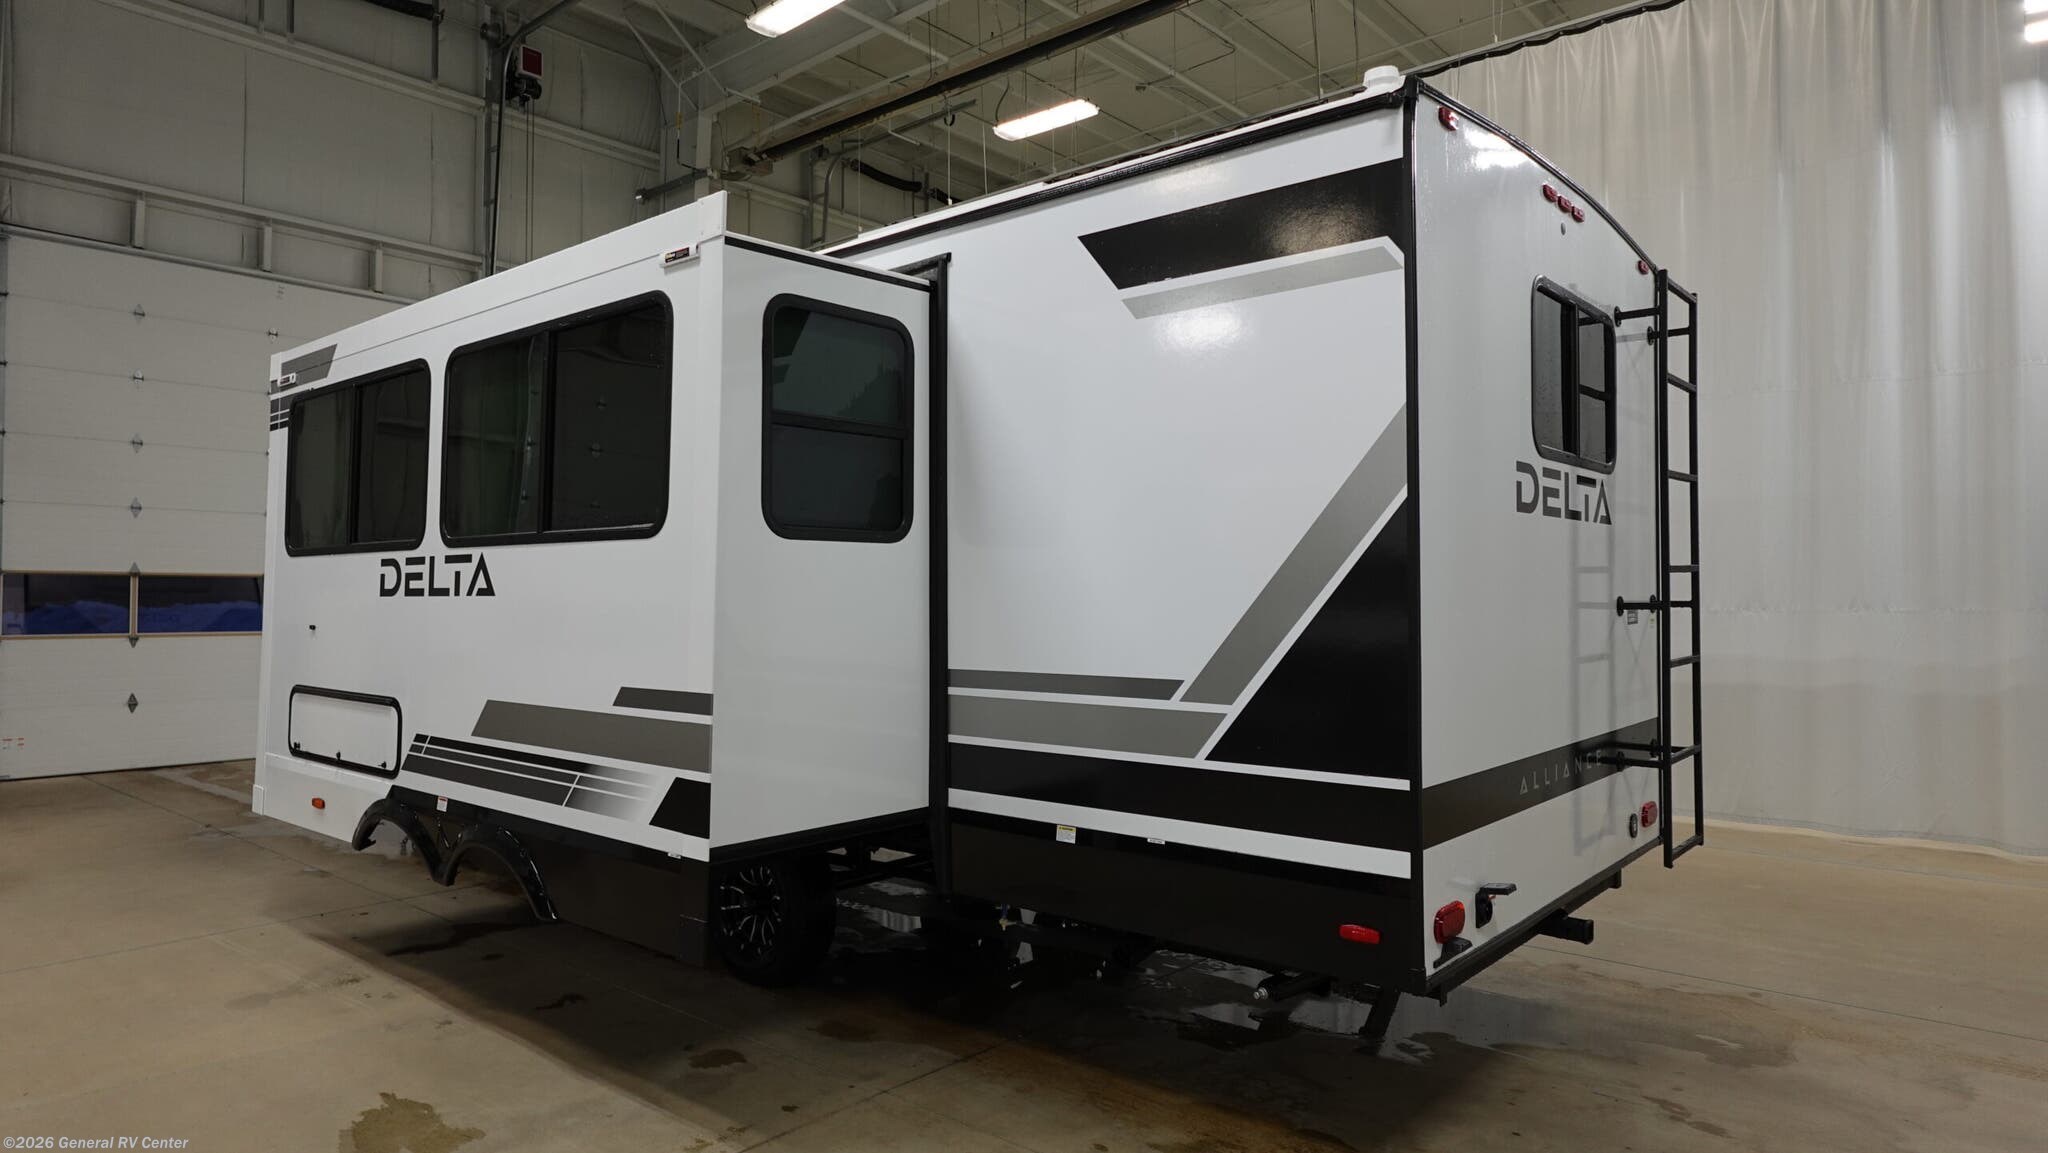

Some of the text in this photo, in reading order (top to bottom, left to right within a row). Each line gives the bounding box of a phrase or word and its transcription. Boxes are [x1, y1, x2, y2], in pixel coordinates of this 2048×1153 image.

[1516, 460, 1612, 525] DELTA
[379, 552, 496, 597] DELTA
[1520, 750, 1602, 795] ALLIANCE
